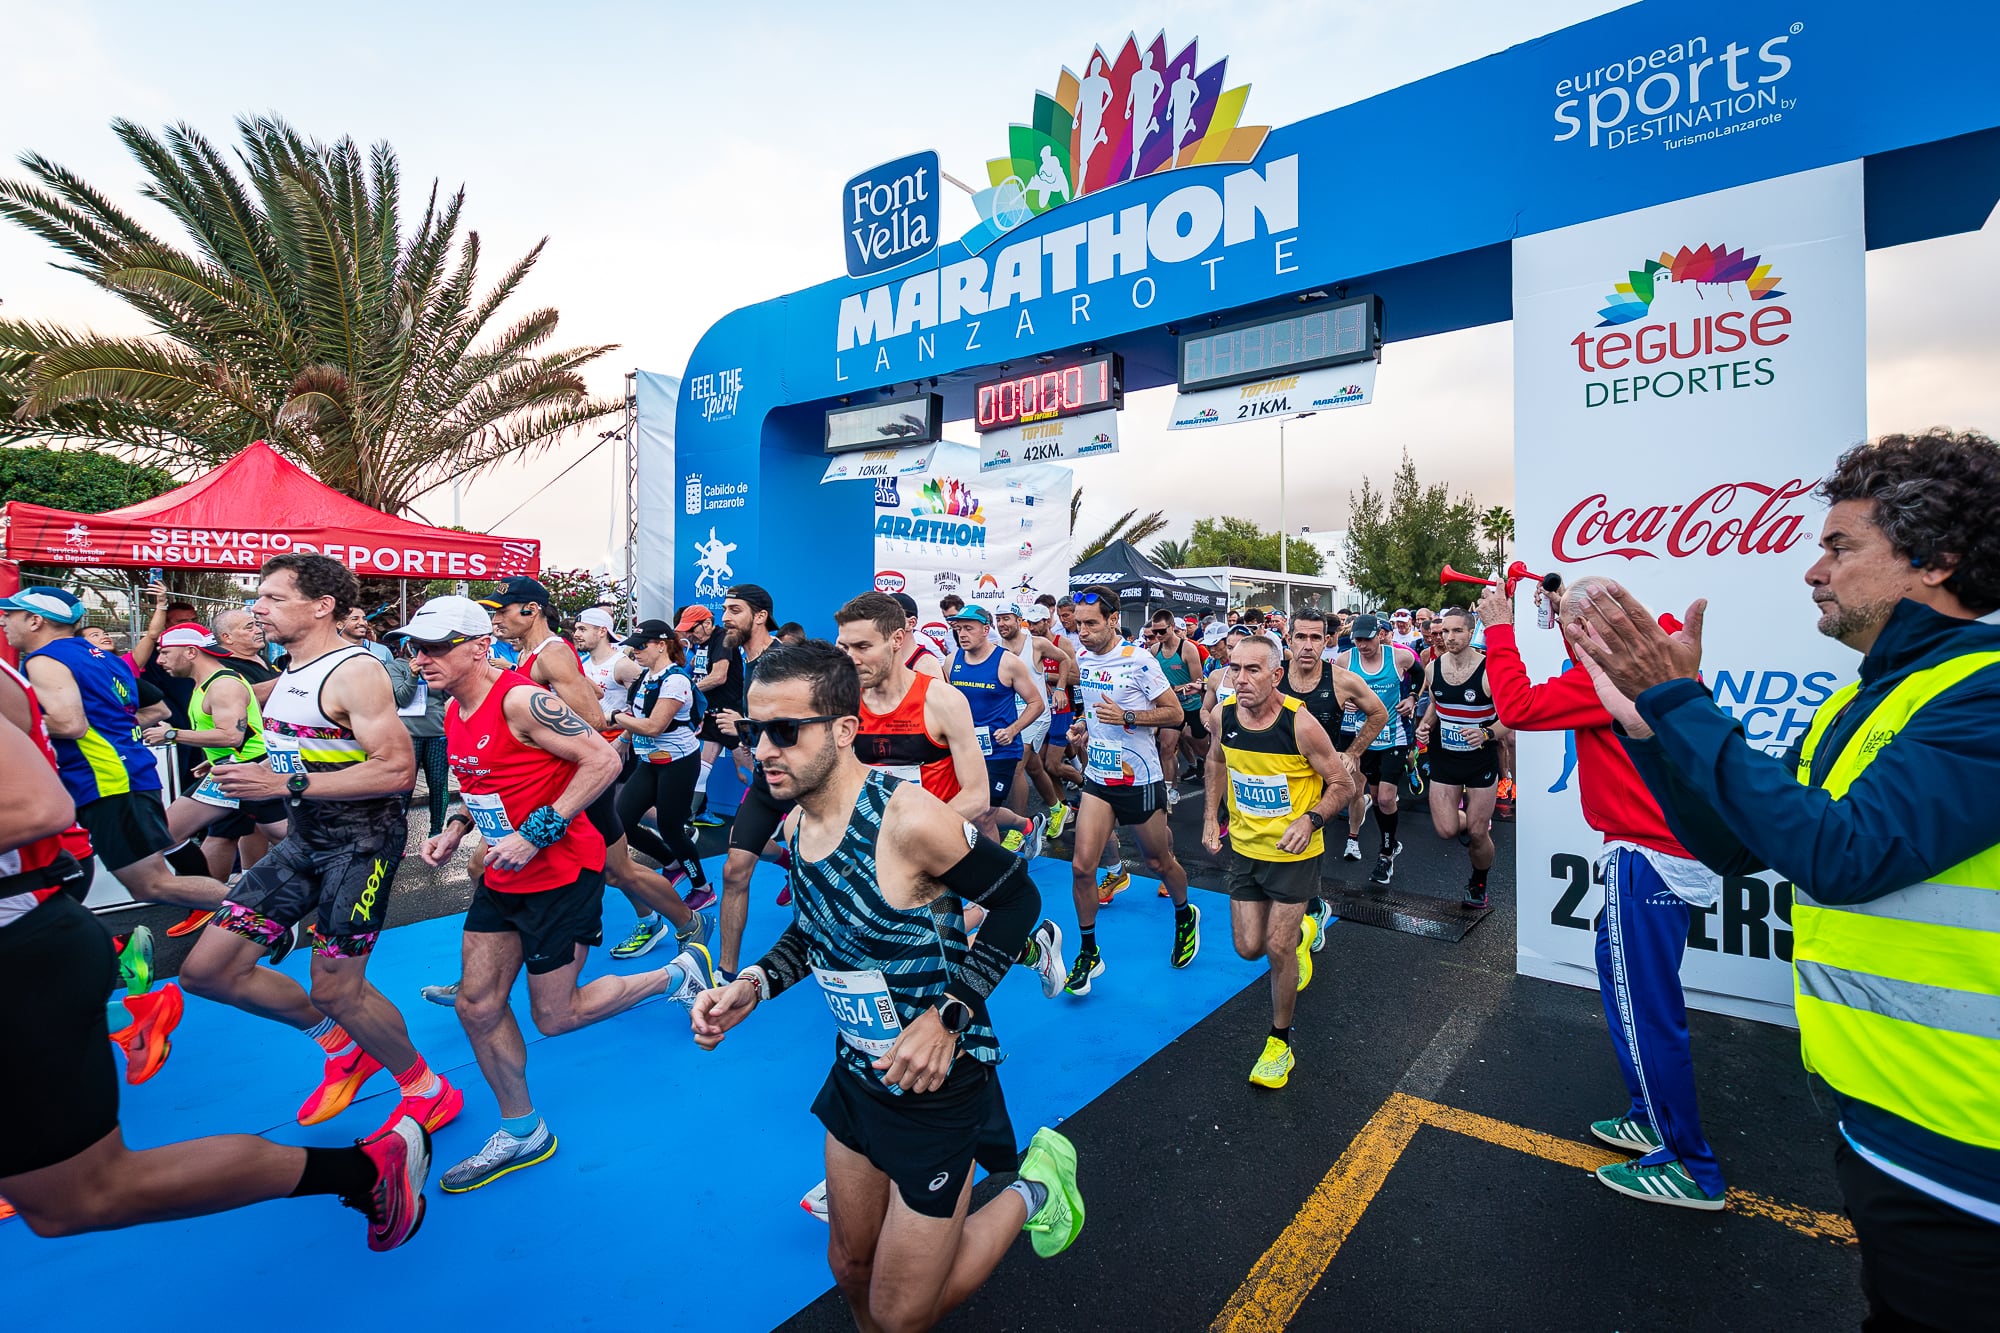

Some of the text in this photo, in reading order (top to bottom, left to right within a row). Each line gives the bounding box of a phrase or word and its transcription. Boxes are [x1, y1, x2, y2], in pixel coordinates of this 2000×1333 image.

[1555, 35, 1707, 97] european
[1552, 35, 1793, 147] sports
[1608, 86, 1797, 150] DESTINATION by
[1662, 112, 1783, 151] TurismoLanzarote
[851, 167, 929, 224] Font
[851, 207, 931, 265] Vella
[837, 153, 1299, 352] MARATHON
[836, 236, 1299, 382] LANZAROTE
[691, 368, 743, 400] FEEL THE
[1240, 376, 1301, 399] TOPTIME
[1585, 357, 1775, 408] DEPORTES
[702, 385, 743, 422] spirit
[1237, 397, 1292, 420] 21KM.
[1312, 393, 1364, 407] MARATHON
[1175, 415, 1219, 426] MARATHON
[1022, 422, 1064, 441] TOPTIME
[1024, 443, 1064, 461] 42KM.
[858, 465, 888, 476] 10KM.
[704, 482, 748, 497] Cabildo de
[875, 488, 898, 505] ella
[704, 497, 745, 510] Lanzarote
[1551, 476, 1822, 563] Coca-Cola
[150, 528, 291, 550] SERVICIO
[875, 515, 986, 547] ARATHON
[47, 546, 107, 556] Servicio Insular
[65, 554, 100, 562] Deportes
[132, 544, 256, 566] INSULAR
[885, 541, 987, 560] NZAROTE
[695, 583, 729, 599] LANZAROT
[971, 590, 1005, 599] Lanzafrut
[1699, 669, 1838, 707] NDS
[1447, 731, 1467, 743] 408
[270, 753, 289, 773] 96
[1091, 748, 1112, 765] 4423
[1244, 787, 1276, 803] 4410
[471, 811, 496, 830] 318
[1646, 898, 1687, 906] LANZAR
